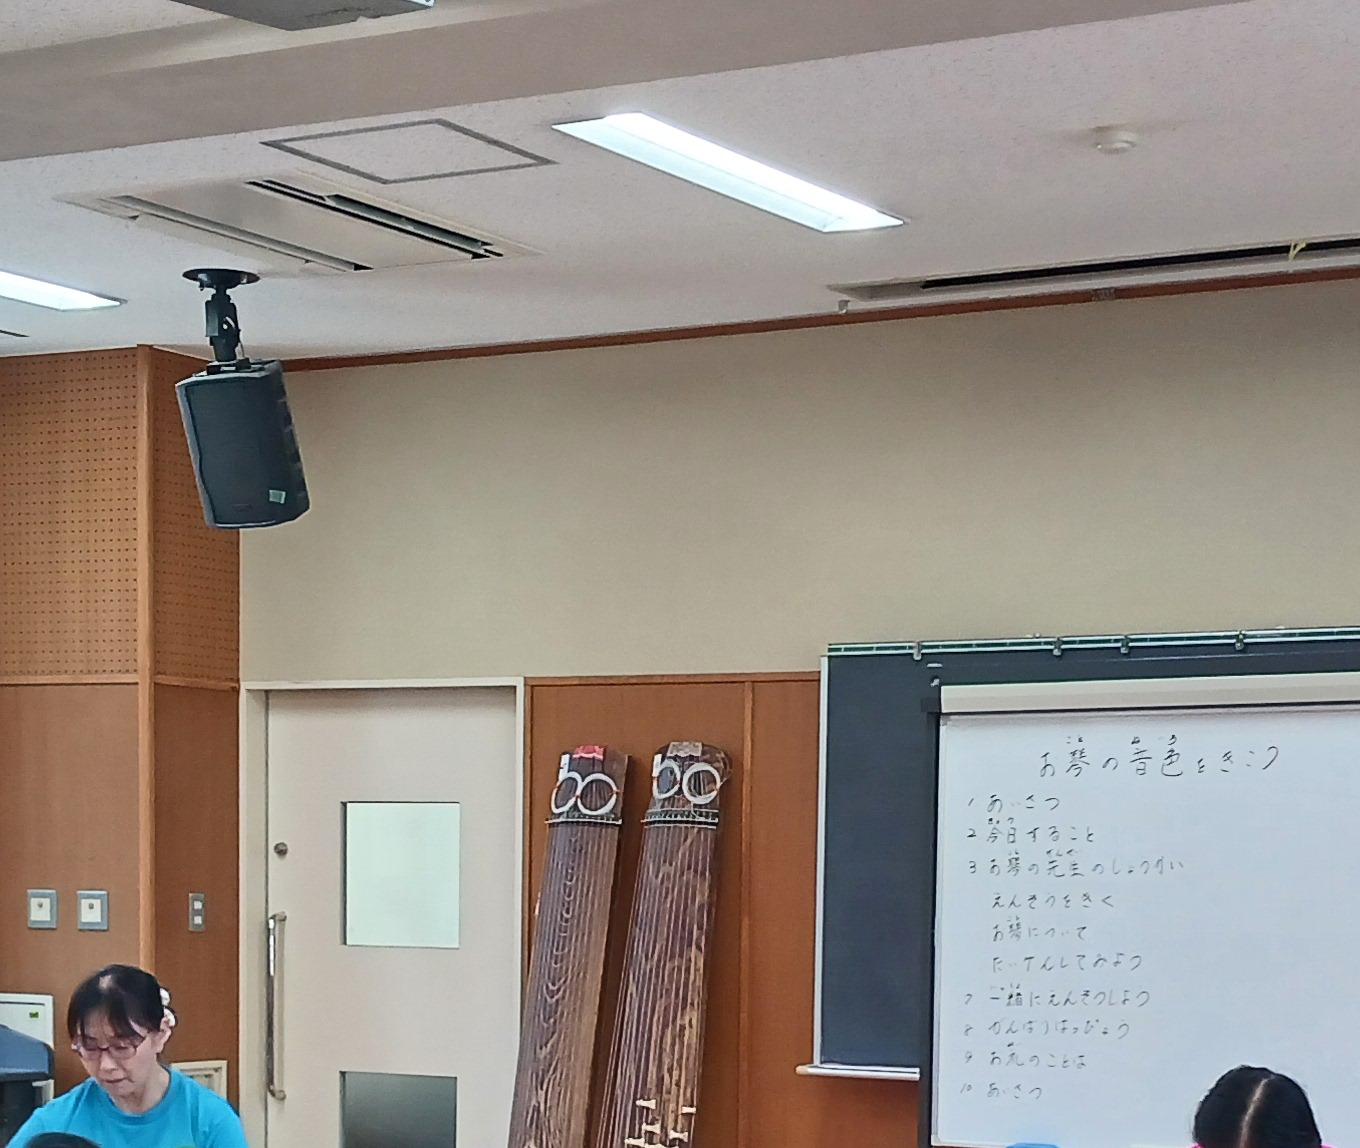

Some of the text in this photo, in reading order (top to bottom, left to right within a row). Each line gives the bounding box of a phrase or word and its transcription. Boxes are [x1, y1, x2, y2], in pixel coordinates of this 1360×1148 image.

[1039, 745, 1279, 778] お琴の音色をきこう
[986, 794, 1060, 813] あいさつ
[966, 826, 1095, 844] 2 今日すること
[968, 860, 977, 874] 3
